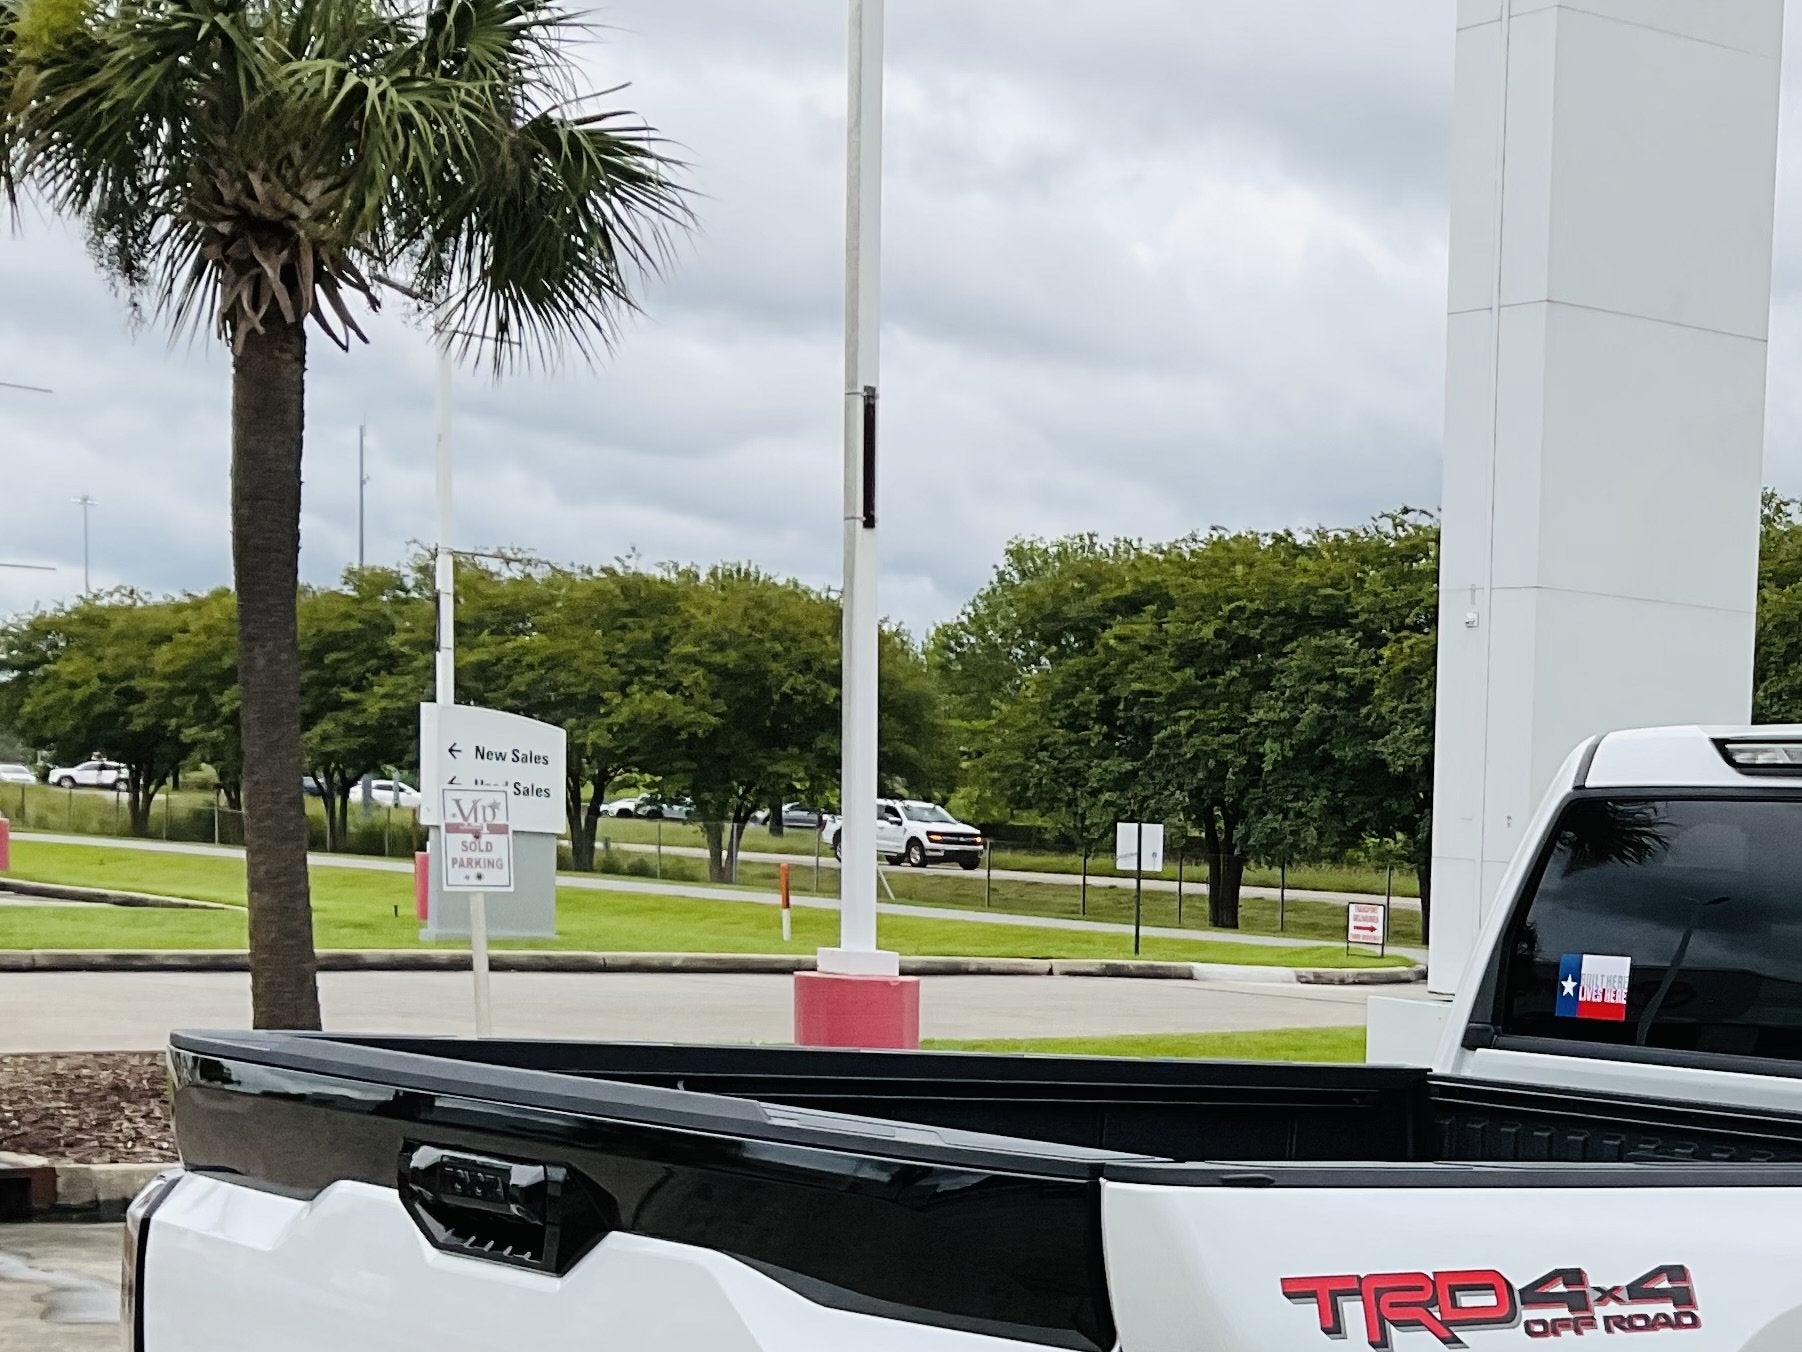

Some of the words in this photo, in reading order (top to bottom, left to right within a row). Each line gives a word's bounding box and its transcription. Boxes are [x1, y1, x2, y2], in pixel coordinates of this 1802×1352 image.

[475, 745, 507, 762] New
[511, 748, 549, 766] Sales
[513, 782, 550, 798] Sales
[461, 840, 493, 853] SOLD
[451, 856, 504, 870] PARKING
[1578, 986, 1603, 1002] LIVES
[1603, 988, 1628, 1004] HERE
[1523, 1316, 1597, 1339] OFF
[1602, 1310, 1702, 1336] ROAD
